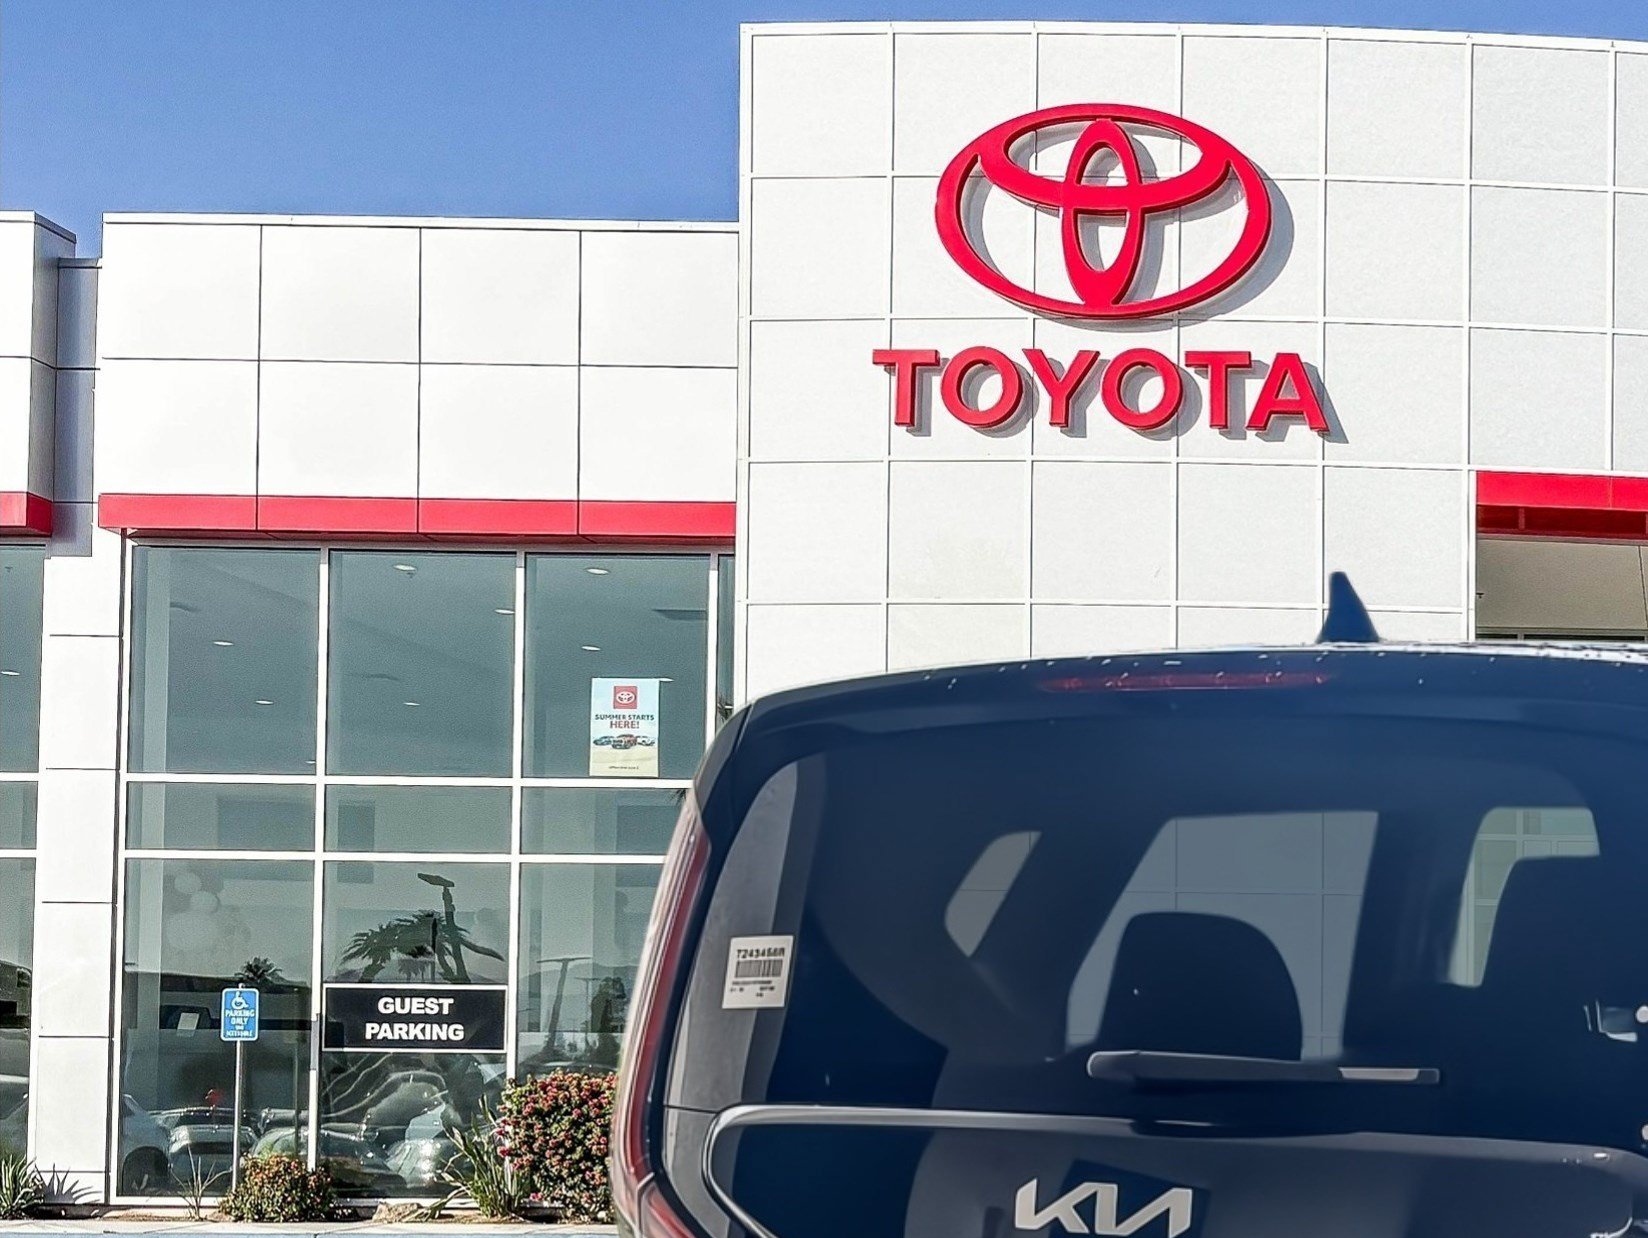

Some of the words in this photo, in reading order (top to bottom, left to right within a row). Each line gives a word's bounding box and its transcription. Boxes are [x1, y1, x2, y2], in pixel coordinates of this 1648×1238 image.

[872, 345, 1329, 432] TOYOTA
[609, 721, 640, 729] HERE!
[377, 997, 455, 1015] GUEST
[225, 1009, 255, 1017] PARKING
[230, 1016, 249, 1025] ONLY
[365, 1022, 464, 1041] PARKING
